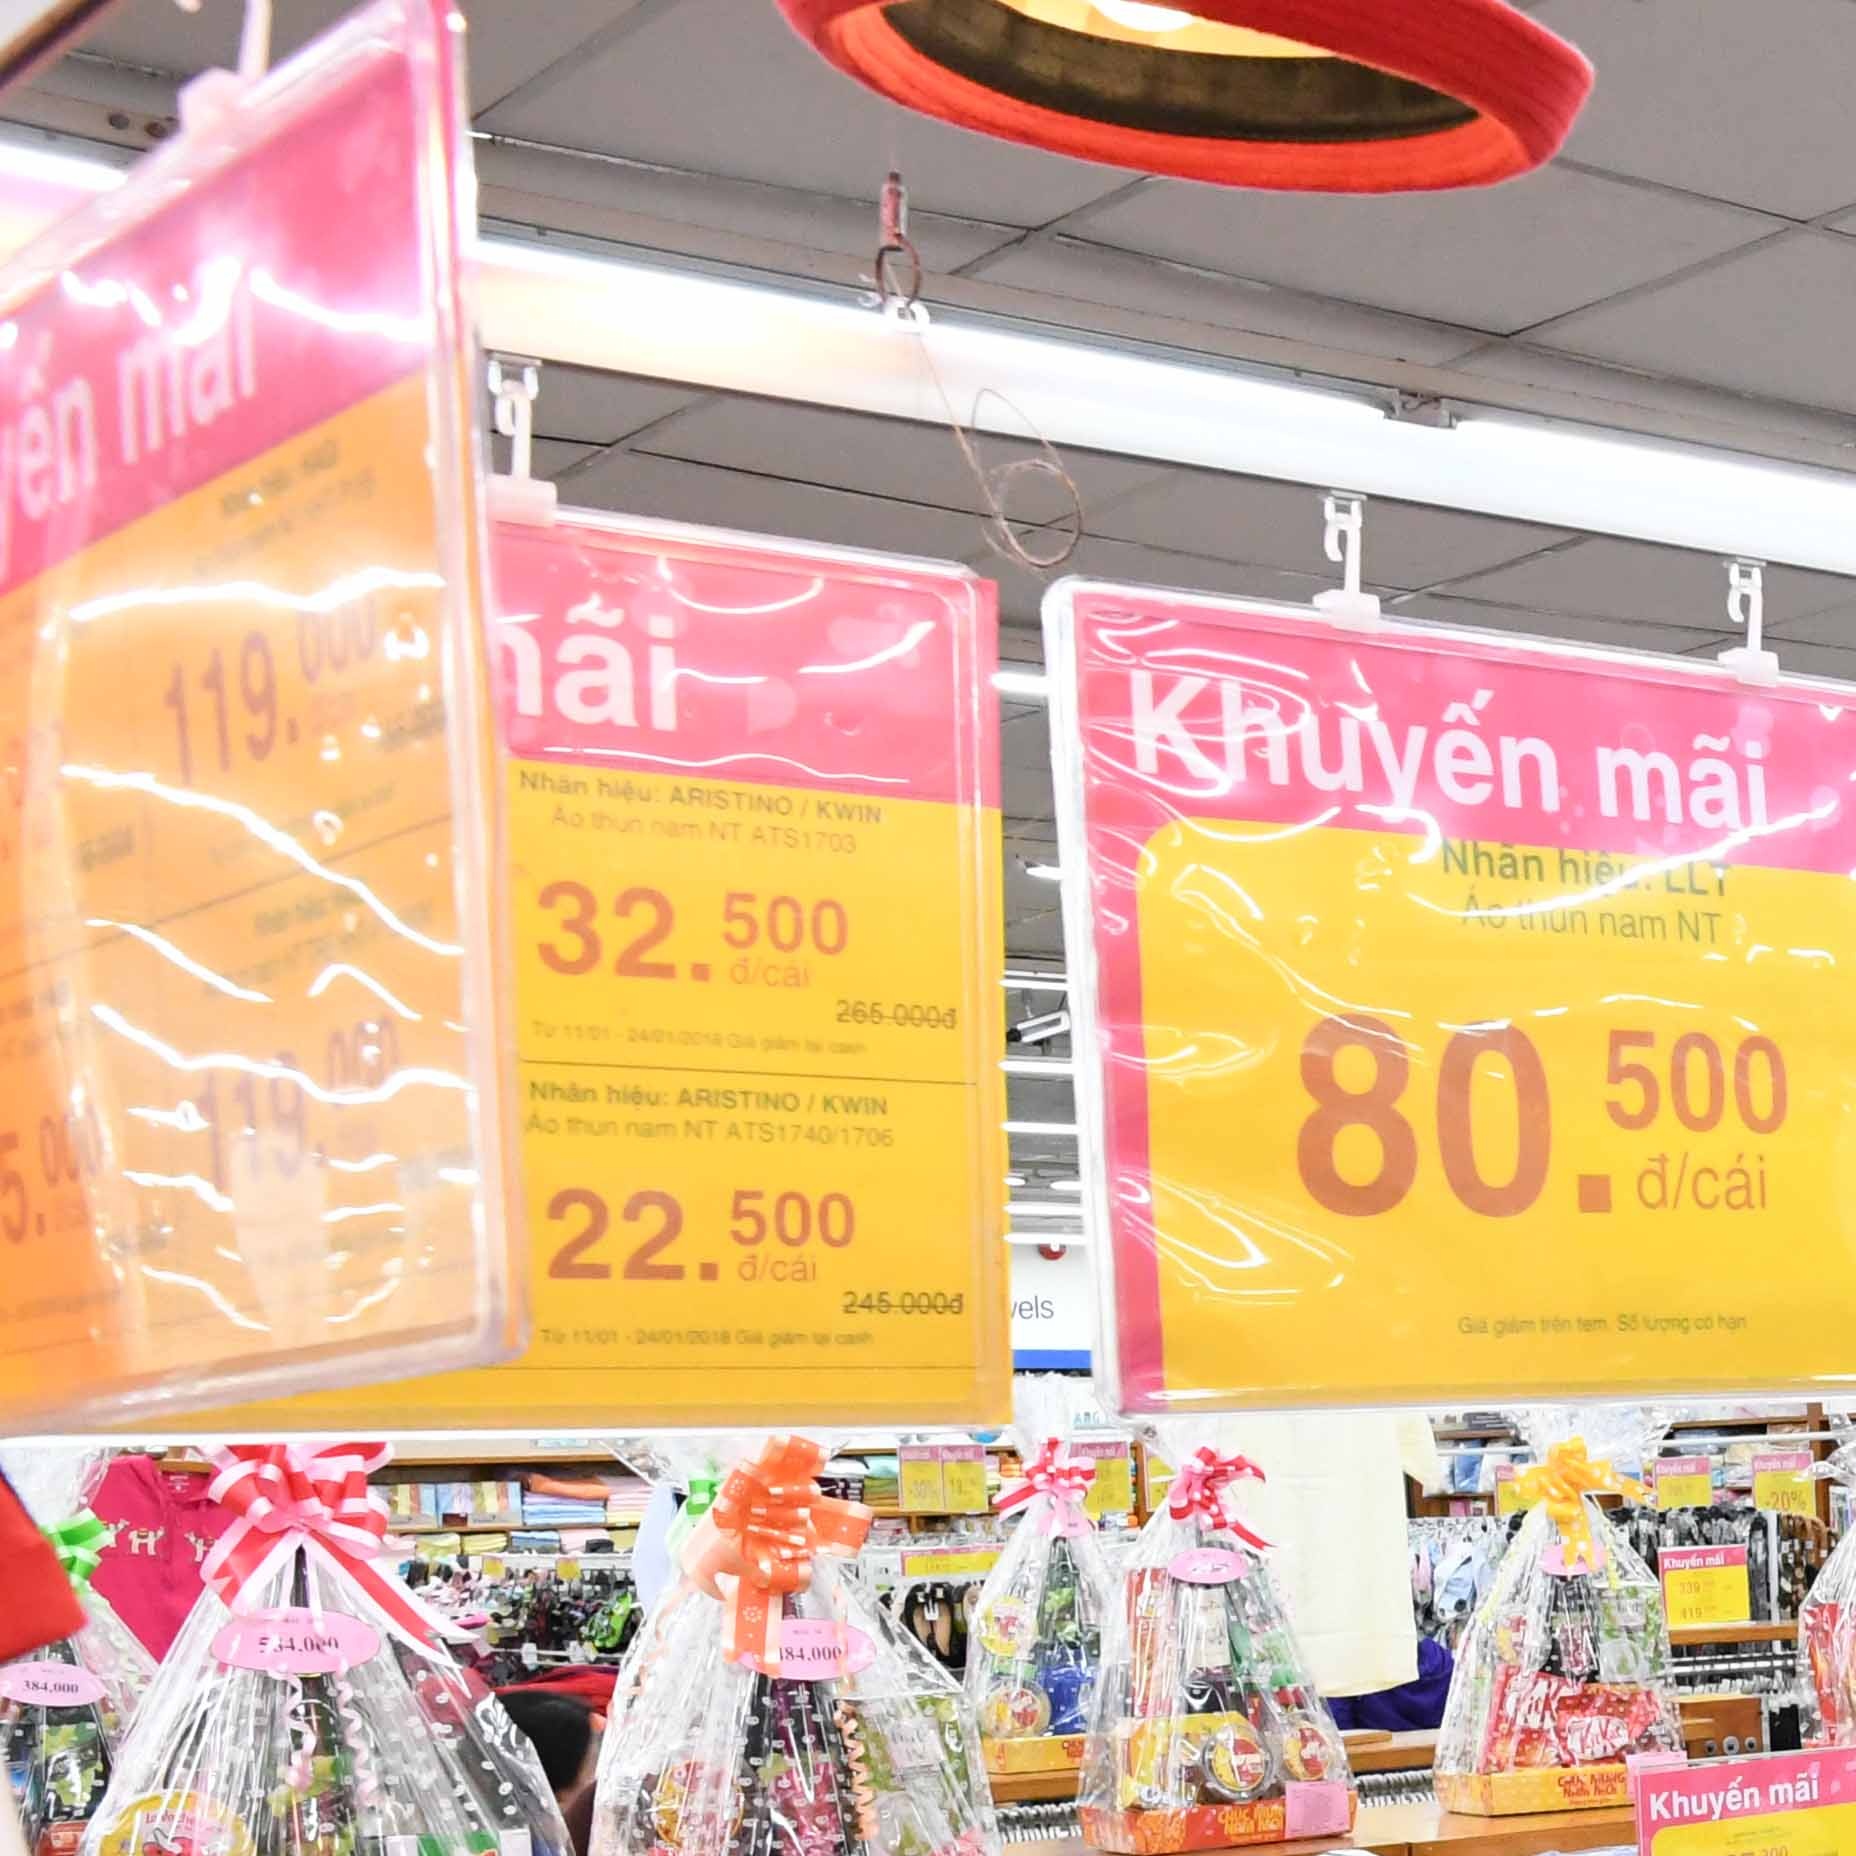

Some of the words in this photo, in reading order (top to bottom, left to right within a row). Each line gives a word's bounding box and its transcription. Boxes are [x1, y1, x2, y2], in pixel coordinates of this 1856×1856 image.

[1127, 667, 1563, 823] Khuyến
[1597, 735, 1771, 833] mãi
[670, 786, 793, 816] ARISTINO
[816, 801, 883, 824] KWIN
[710, 820, 741, 845] NT
[751, 826, 858, 854] ATS1703
[1599, 911, 1668, 941] nam
[1677, 910, 1722, 944] NT
[677, 1088, 801, 1112] ARISTINO
[822, 1095, 888, 1116] KWIN
[684, 1119, 717, 1140] NT
[1636, 1154, 1769, 1214] đ/cái
[1650, 1775, 1760, 1822] Khuyến
[1768, 1773, 1819, 1805] mãi
